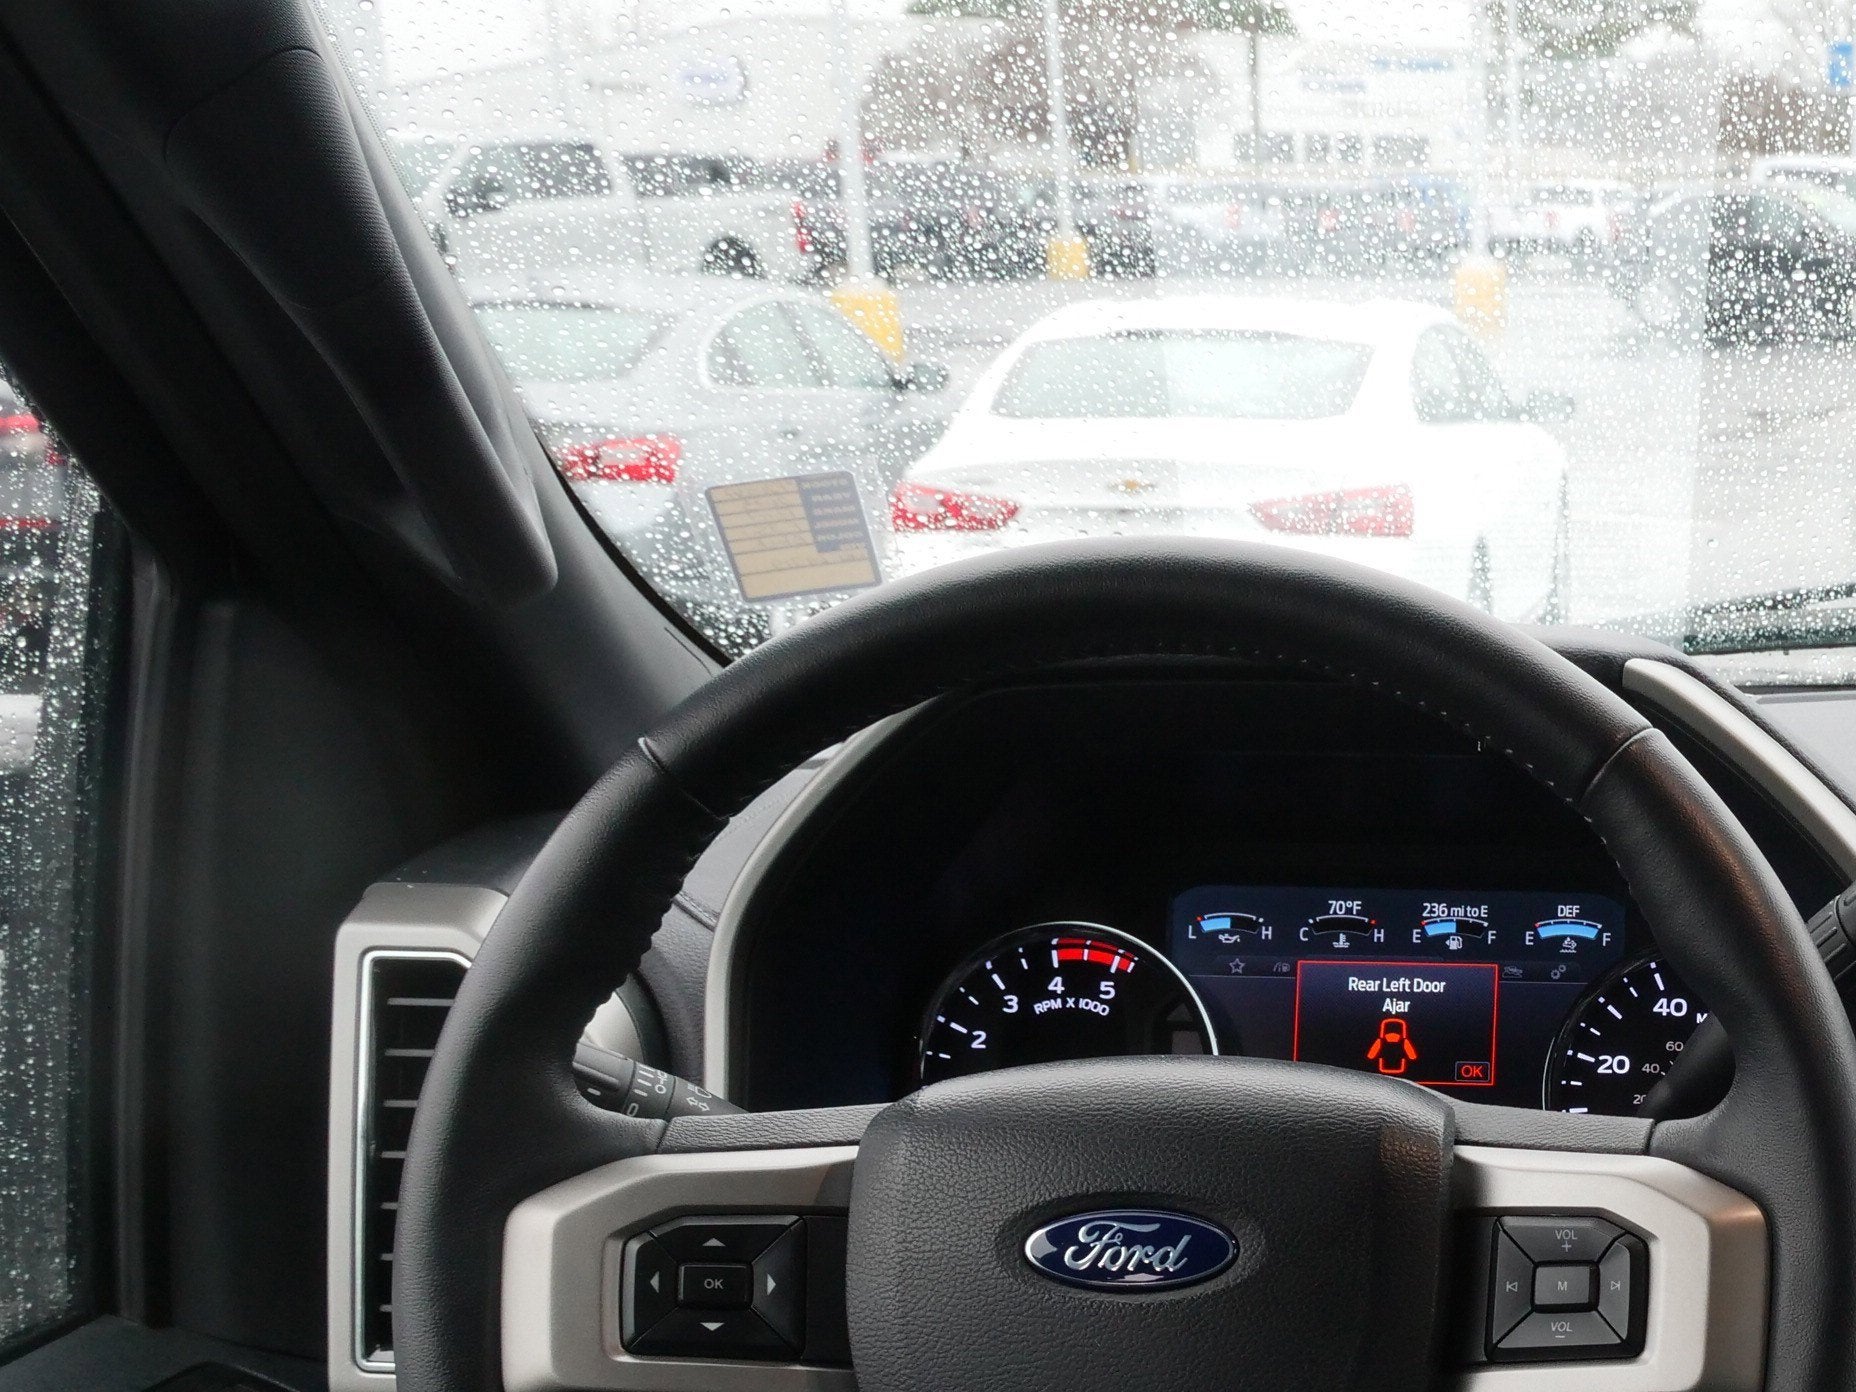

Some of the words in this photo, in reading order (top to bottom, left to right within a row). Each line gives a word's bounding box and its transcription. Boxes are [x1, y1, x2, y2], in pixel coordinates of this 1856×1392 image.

[1328, 900, 1361, 915] 70°F
[1423, 903, 1447, 917] 236
[1451, 904, 1464, 917] mi
[1466, 905, 1479, 917] to
[1480, 905, 1488, 917] E
[1557, 905, 1580, 918] DEF
[1188, 926, 1196, 939] L
[1262, 926, 1272, 940] H
[1300, 928, 1309, 941] C
[1374, 929, 1384, 943] H
[1413, 930, 1421, 944] E
[1488, 931, 1496, 944] F
[1525, 932, 1534, 946] E
[1602, 933, 1611, 946] F
[1048, 976, 1065, 995] 4
[1100, 981, 1115, 1000] 5
[1348, 976, 1379, 992] Rear
[1382, 977, 1410, 993] Left
[1413, 977, 1446, 994] Door
[1003, 995, 1018, 1013] 3
[1033, 997, 1062, 1016] RPM
[1066, 997, 1076, 1009] X
[1079, 999, 1110, 1017] 1000
[1382, 998, 1410, 1015] Ajar
[1652, 997, 1688, 1018] 40
[971, 1031, 987, 1049] 2
[1665, 1040, 1684, 1052] 60
[1461, 1064, 1483, 1079] OK
[1597, 1055, 1630, 1074] 20
[1641, 1063, 1660, 1074] 40
[1555, 1229, 1578, 1241] VOL
[1063, 1219, 1192, 1272] Ford
[703, 1278, 724, 1290] OK
[1557, 1280, 1568, 1291] M
[1550, 1321, 1573, 1333] VOL
